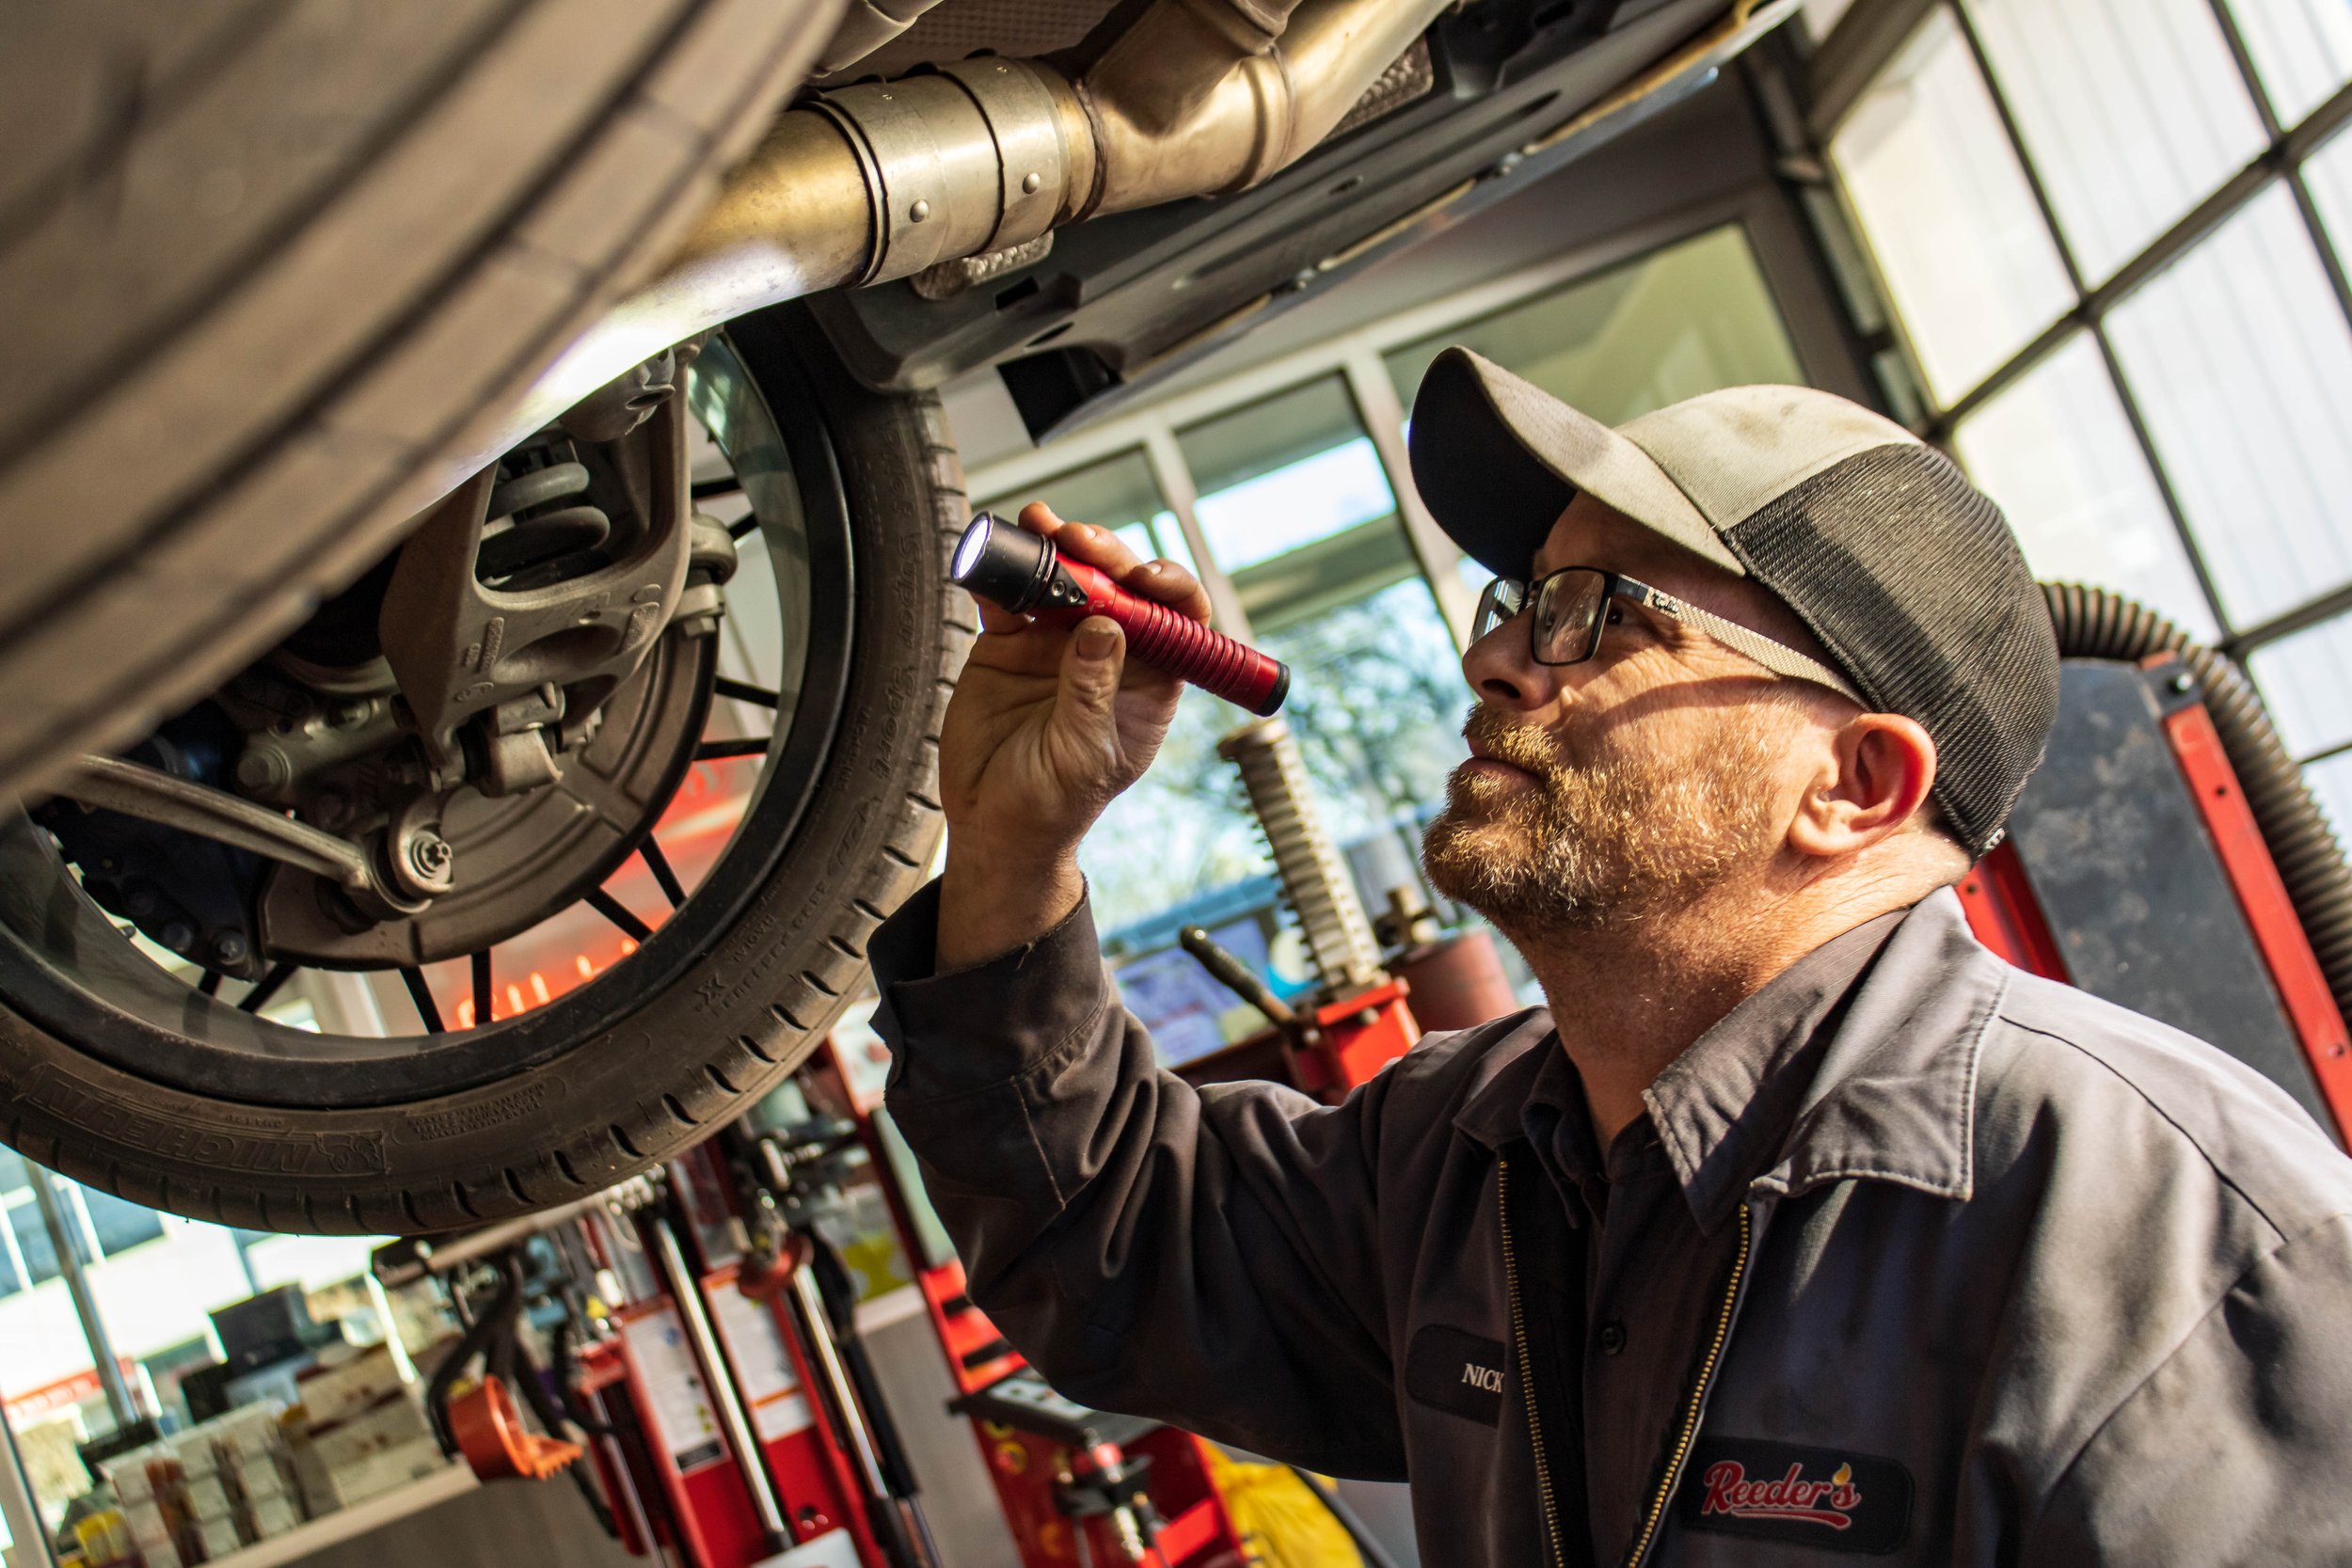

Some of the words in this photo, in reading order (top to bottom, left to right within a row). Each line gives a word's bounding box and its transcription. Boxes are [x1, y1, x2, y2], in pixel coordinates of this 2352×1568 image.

[896, 533, 922, 649] Super
[869, 666, 917, 781] Sport
[35, 1079, 316, 1173] MICHELIN
[1461, 1362, 1505, 1393] NICK
[1700, 1460, 1863, 1516] Reeder's
